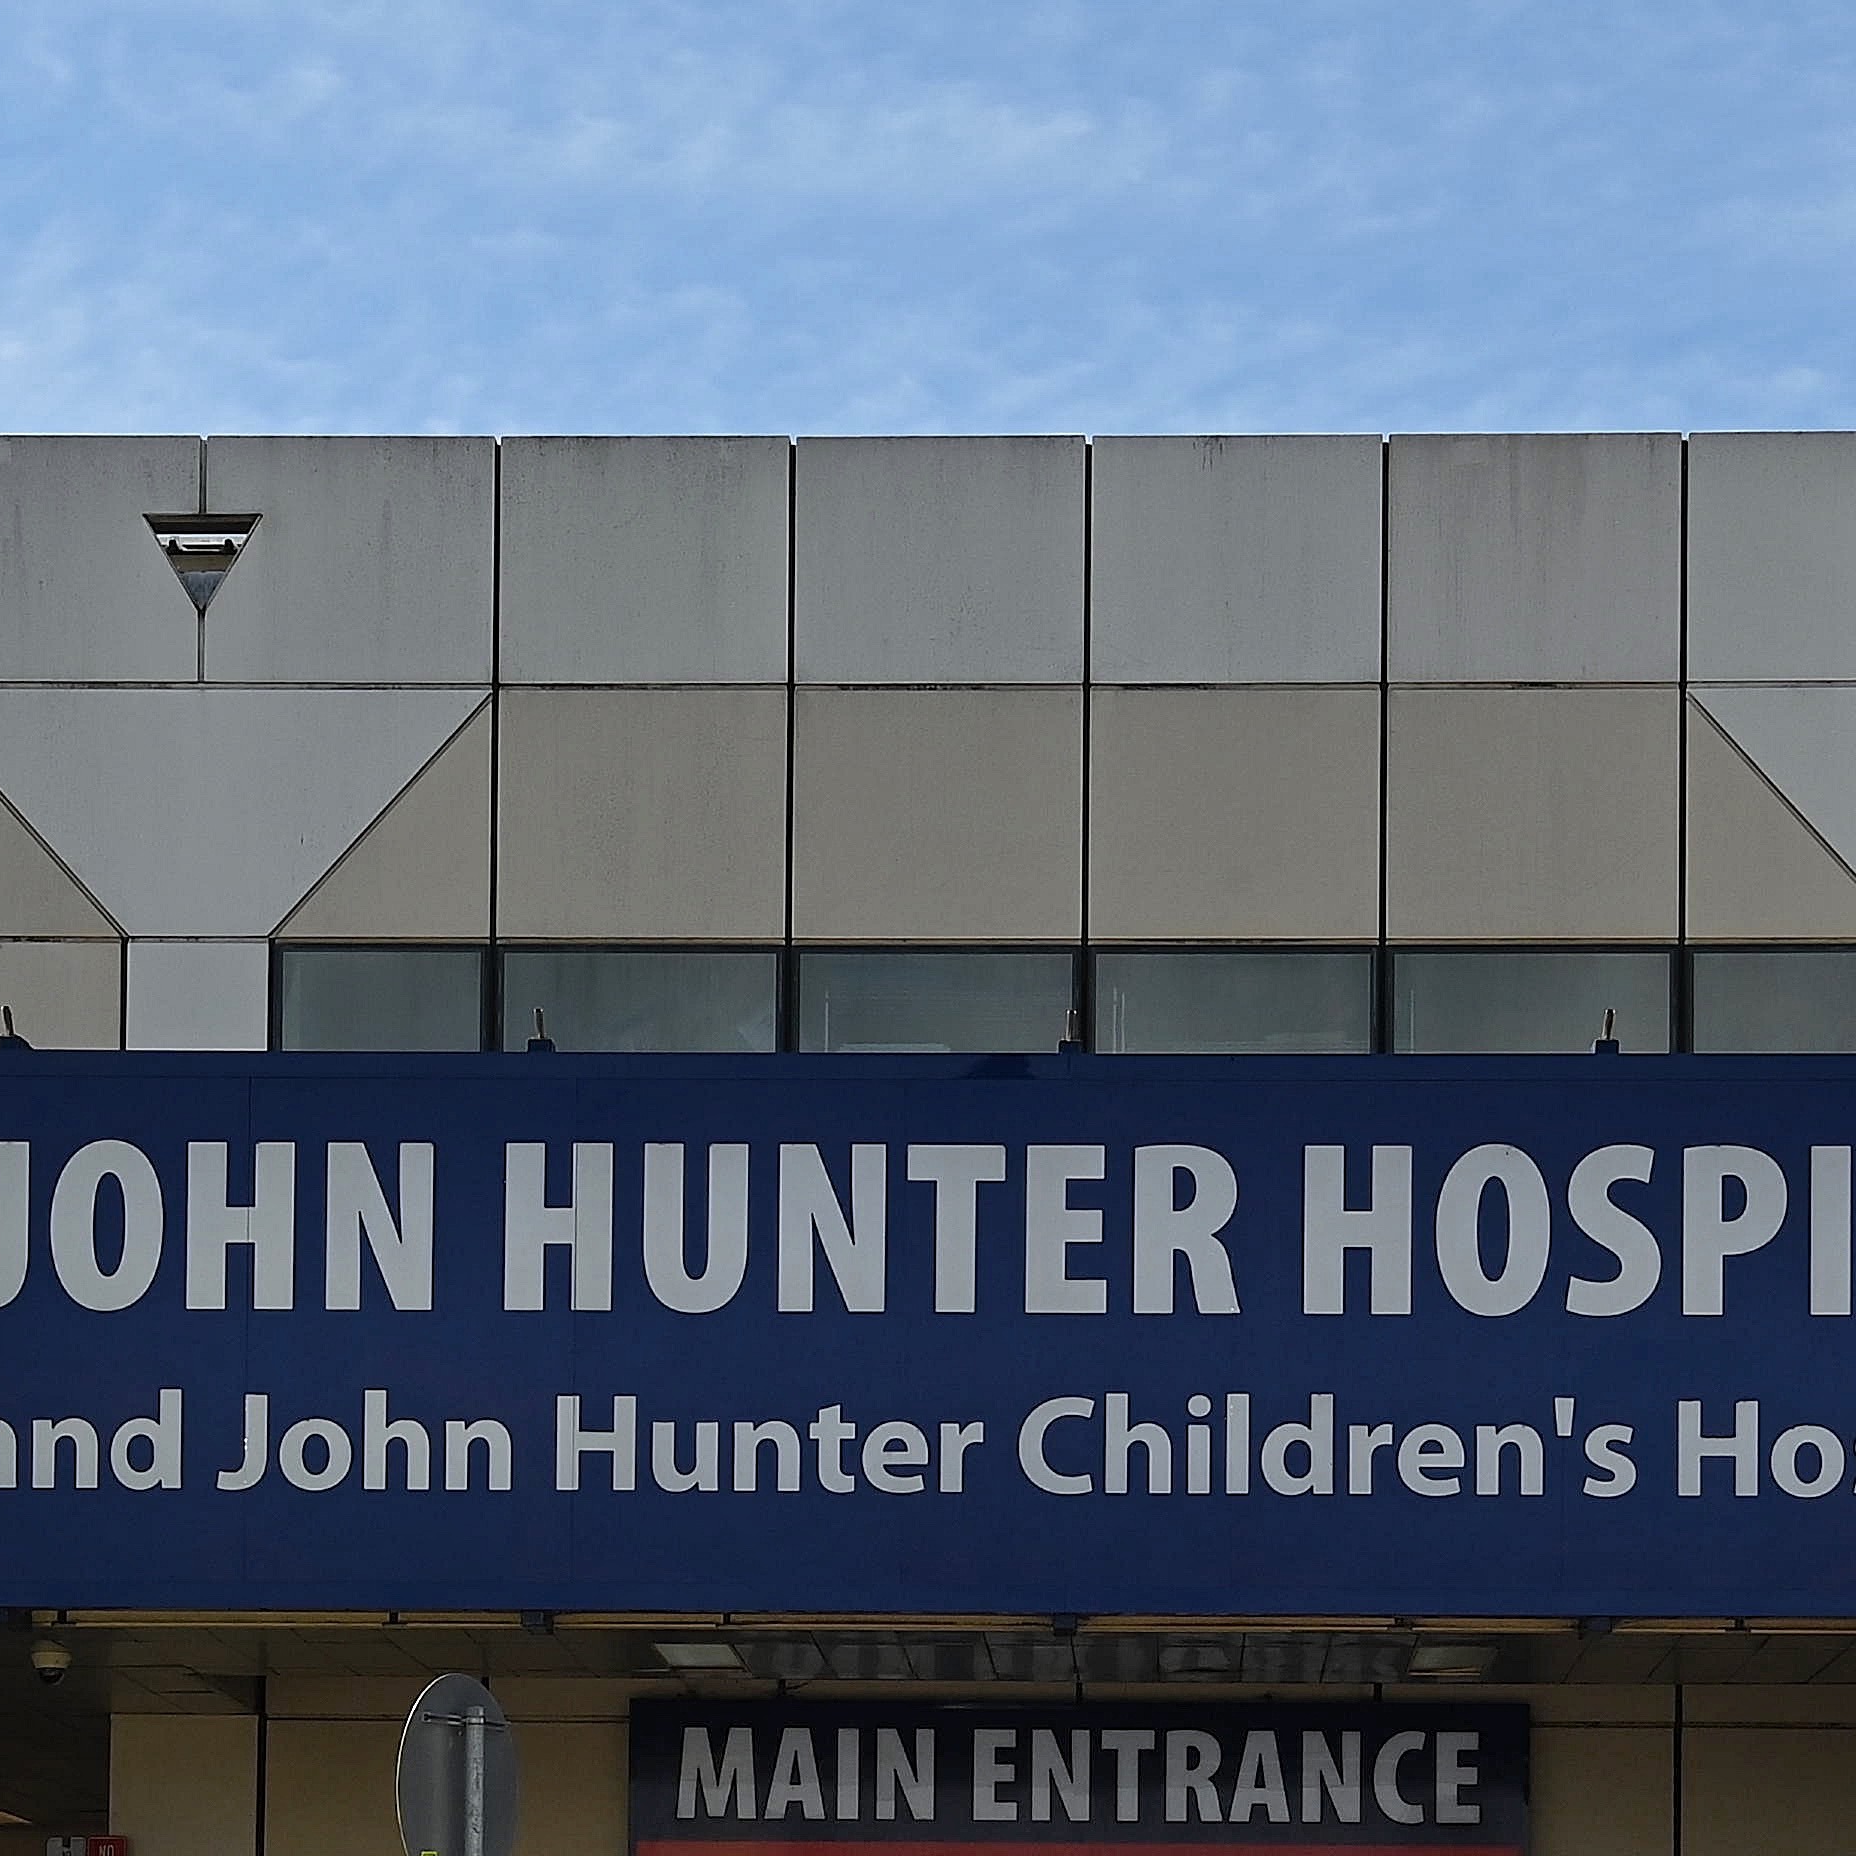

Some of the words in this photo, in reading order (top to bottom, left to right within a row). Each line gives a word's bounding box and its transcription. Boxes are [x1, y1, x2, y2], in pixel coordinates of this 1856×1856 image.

[505, 1143, 1240, 1313] HUNTER
[217, 1390, 511, 1490] John
[557, 1396, 983, 1493] Hunter
[1019, 1394, 1636, 1497] Children's
[677, 1728, 934, 1820] MAIN
[973, 1728, 1480, 1823] ENTRANCE
